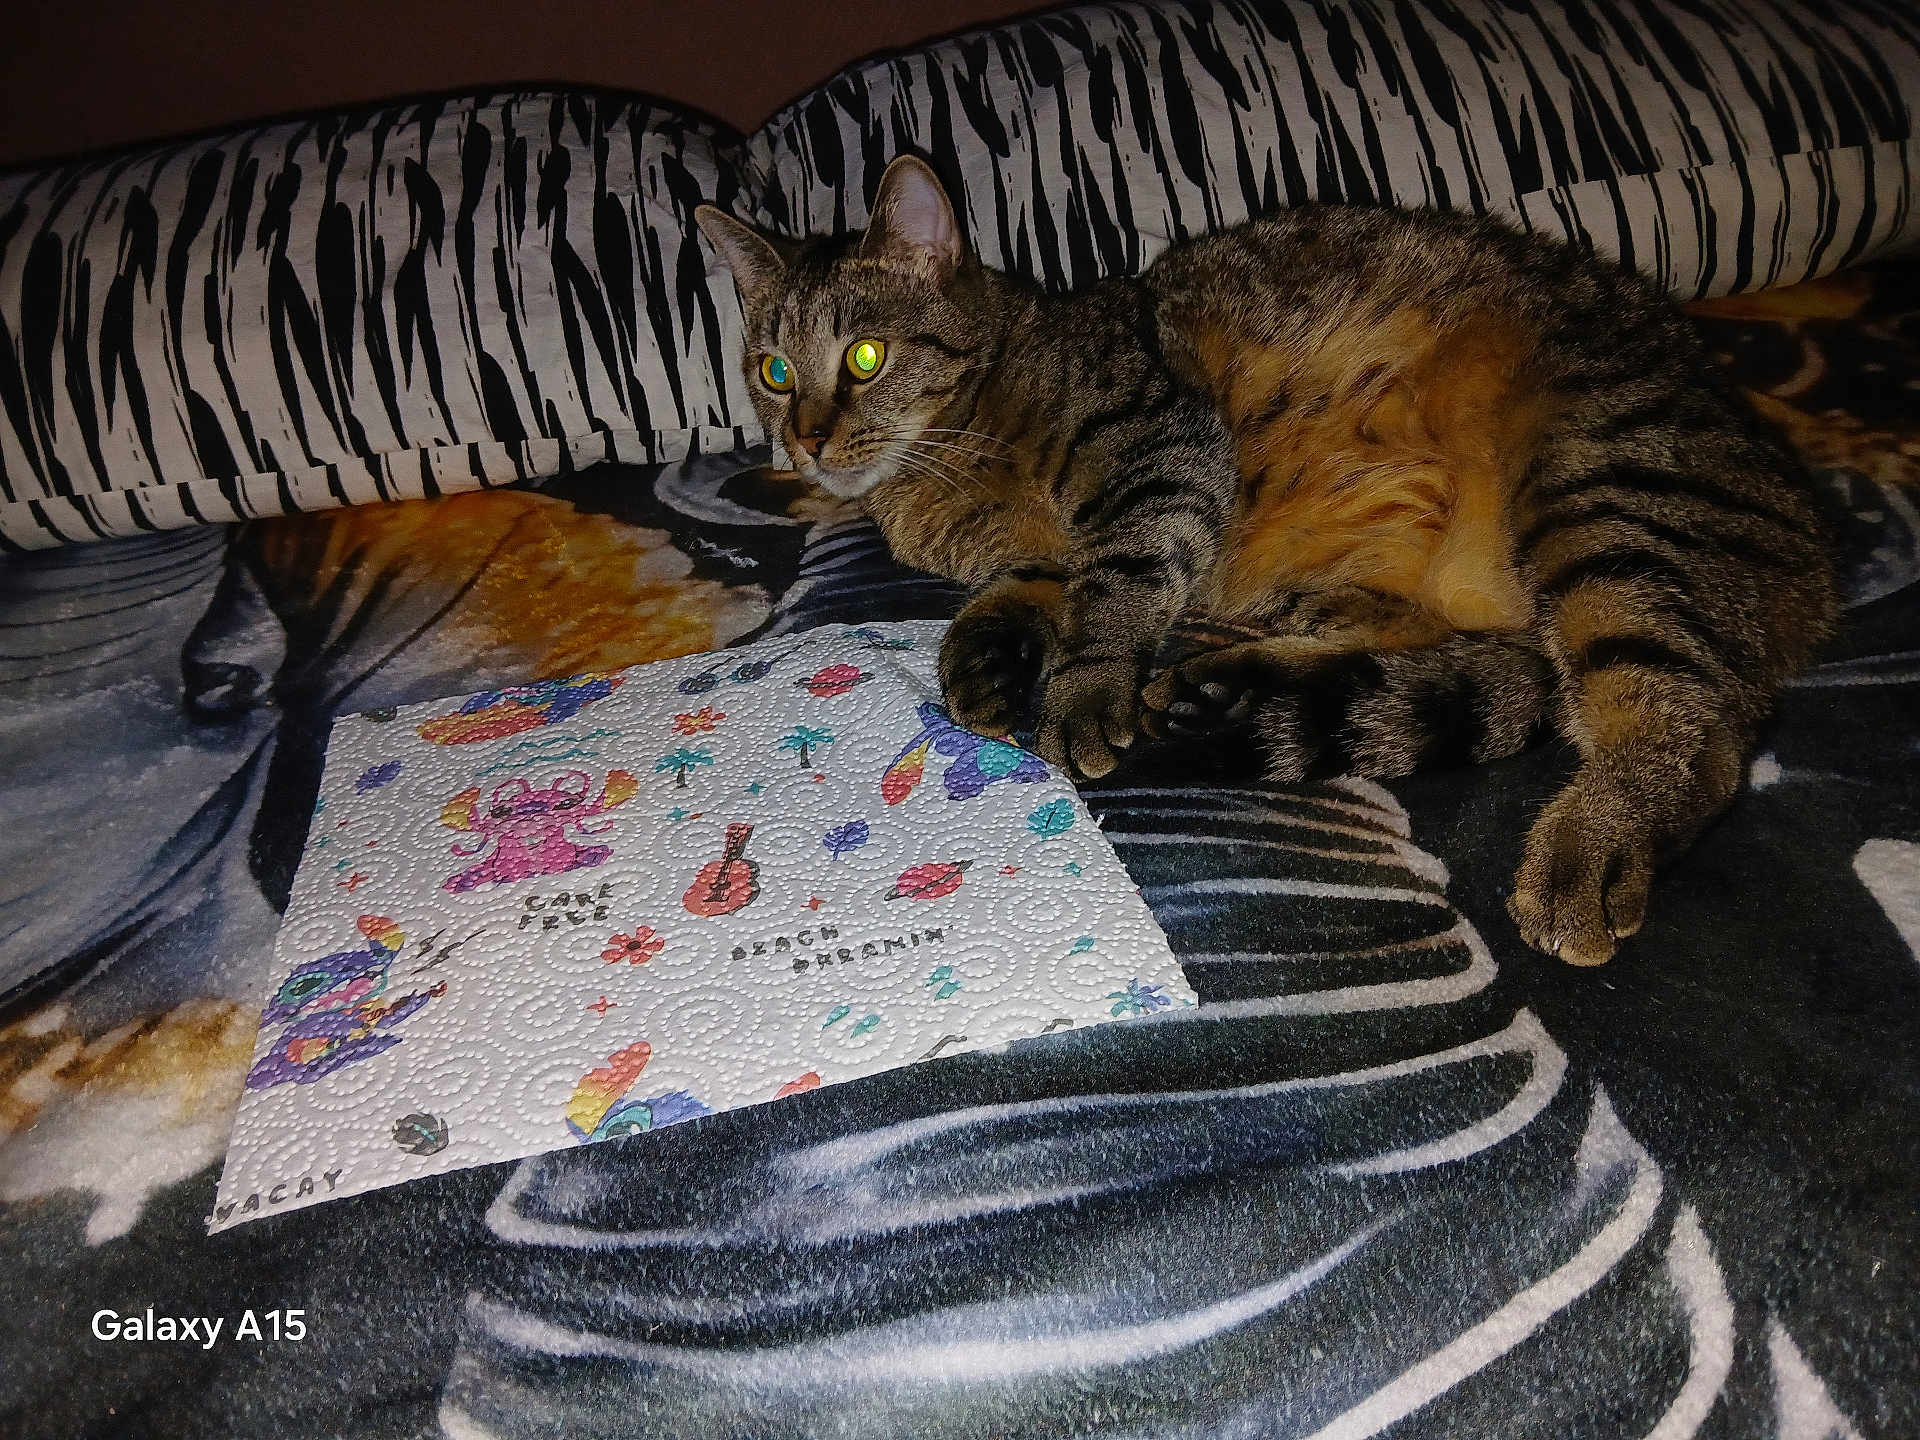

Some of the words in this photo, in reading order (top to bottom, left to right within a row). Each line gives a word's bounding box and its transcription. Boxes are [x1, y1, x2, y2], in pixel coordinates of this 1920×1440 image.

[524, 882, 615, 912] CARE
[518, 905, 610, 931] FREE
[215, 1168, 343, 1224] VACAY
